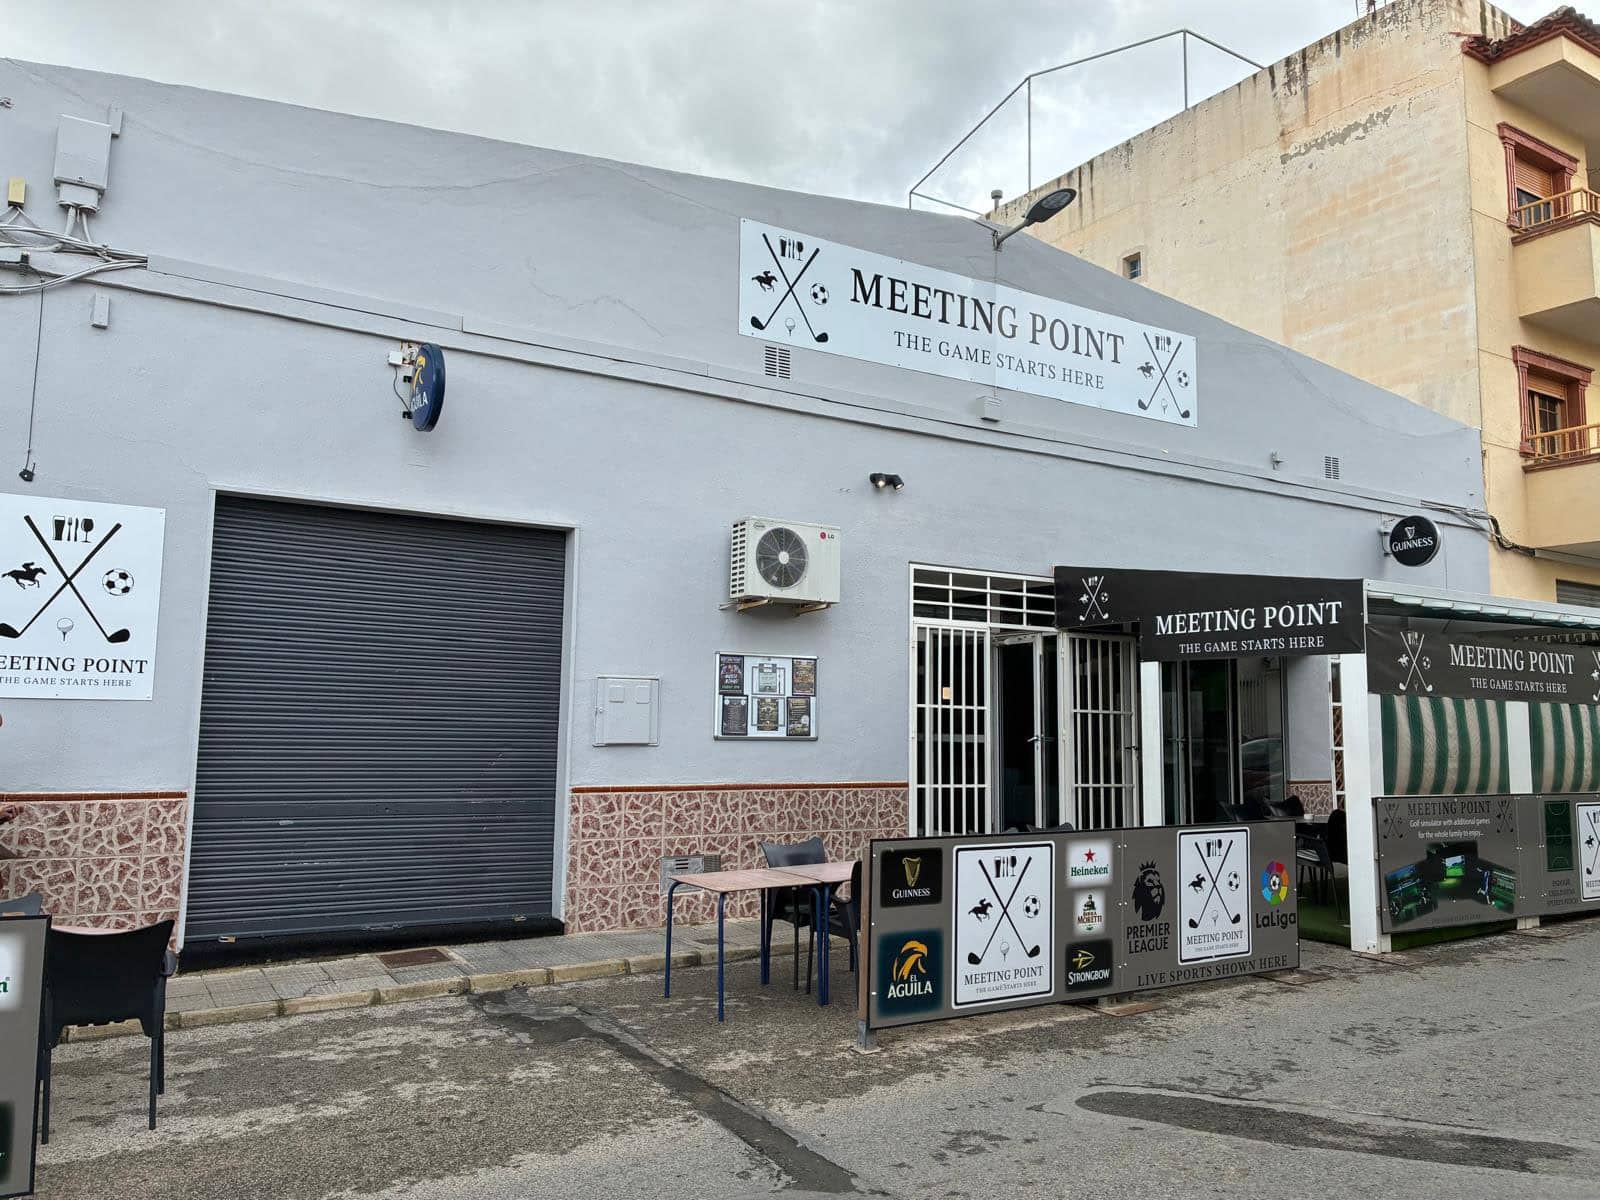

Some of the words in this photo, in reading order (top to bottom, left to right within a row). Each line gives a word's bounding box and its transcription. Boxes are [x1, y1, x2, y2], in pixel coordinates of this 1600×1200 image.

[850, 267, 1018, 339] MEETING
[1029, 312, 1124, 364] POINT
[894, 331, 932, 353] THE
[938, 341, 991, 365] GAME
[996, 353, 1056, 380] STARTS
[1062, 367, 1104, 389] HERE
[1392, 536, 1433, 552] GUINNESS
[1155, 608, 1256, 635] MEETING
[1264, 601, 1342, 628] POINT
[1179, 643, 1201, 654] THE
[1204, 641, 1238, 652] GAME
[1241, 637, 1285, 651] STARTS
[1289, 636, 1325, 649] HERE
[0, 655, 75, 672] EETING
[82, 658, 148, 673] POINT
[1449, 643, 1524, 671] MEETING
[1529, 651, 1575, 675] POINT
[0, 676, 20, 684] THE
[24, 677, 57, 685] GAME
[60, 678, 99, 686] STARTS
[103, 679, 132, 687] HERE
[1470, 677, 1488, 689] THE
[1490, 678, 1514, 691] GAME
[1514, 680, 1545, 692] STARTS
[1546, 682, 1568, 694] HERE
[1408, 801, 1457, 817] MEETING
[1460, 800, 1491, 814] POINT
[1071, 865, 1109, 877] Heineken
[892, 888, 930, 899] GUINNESS
[1255, 909, 1296, 930] LaLiga
[1127, 922, 1170, 940] PREMIER
[1186, 932, 1220, 946] MEETING
[1221, 930, 1243, 941] POINT
[1129, 936, 1169, 954] LEAGUE
[910, 974, 917, 982] EL
[964, 970, 1011, 986] MEETING
[1014, 966, 1044, 979] POINT
[1068, 969, 1110, 985] STRONGBOW
[1138, 972, 1166, 986] LIVE
[1170, 966, 1212, 982] SPORTS
[1215, 960, 1256, 976] SHOWN
[1260, 954, 1288, 969] HERE
